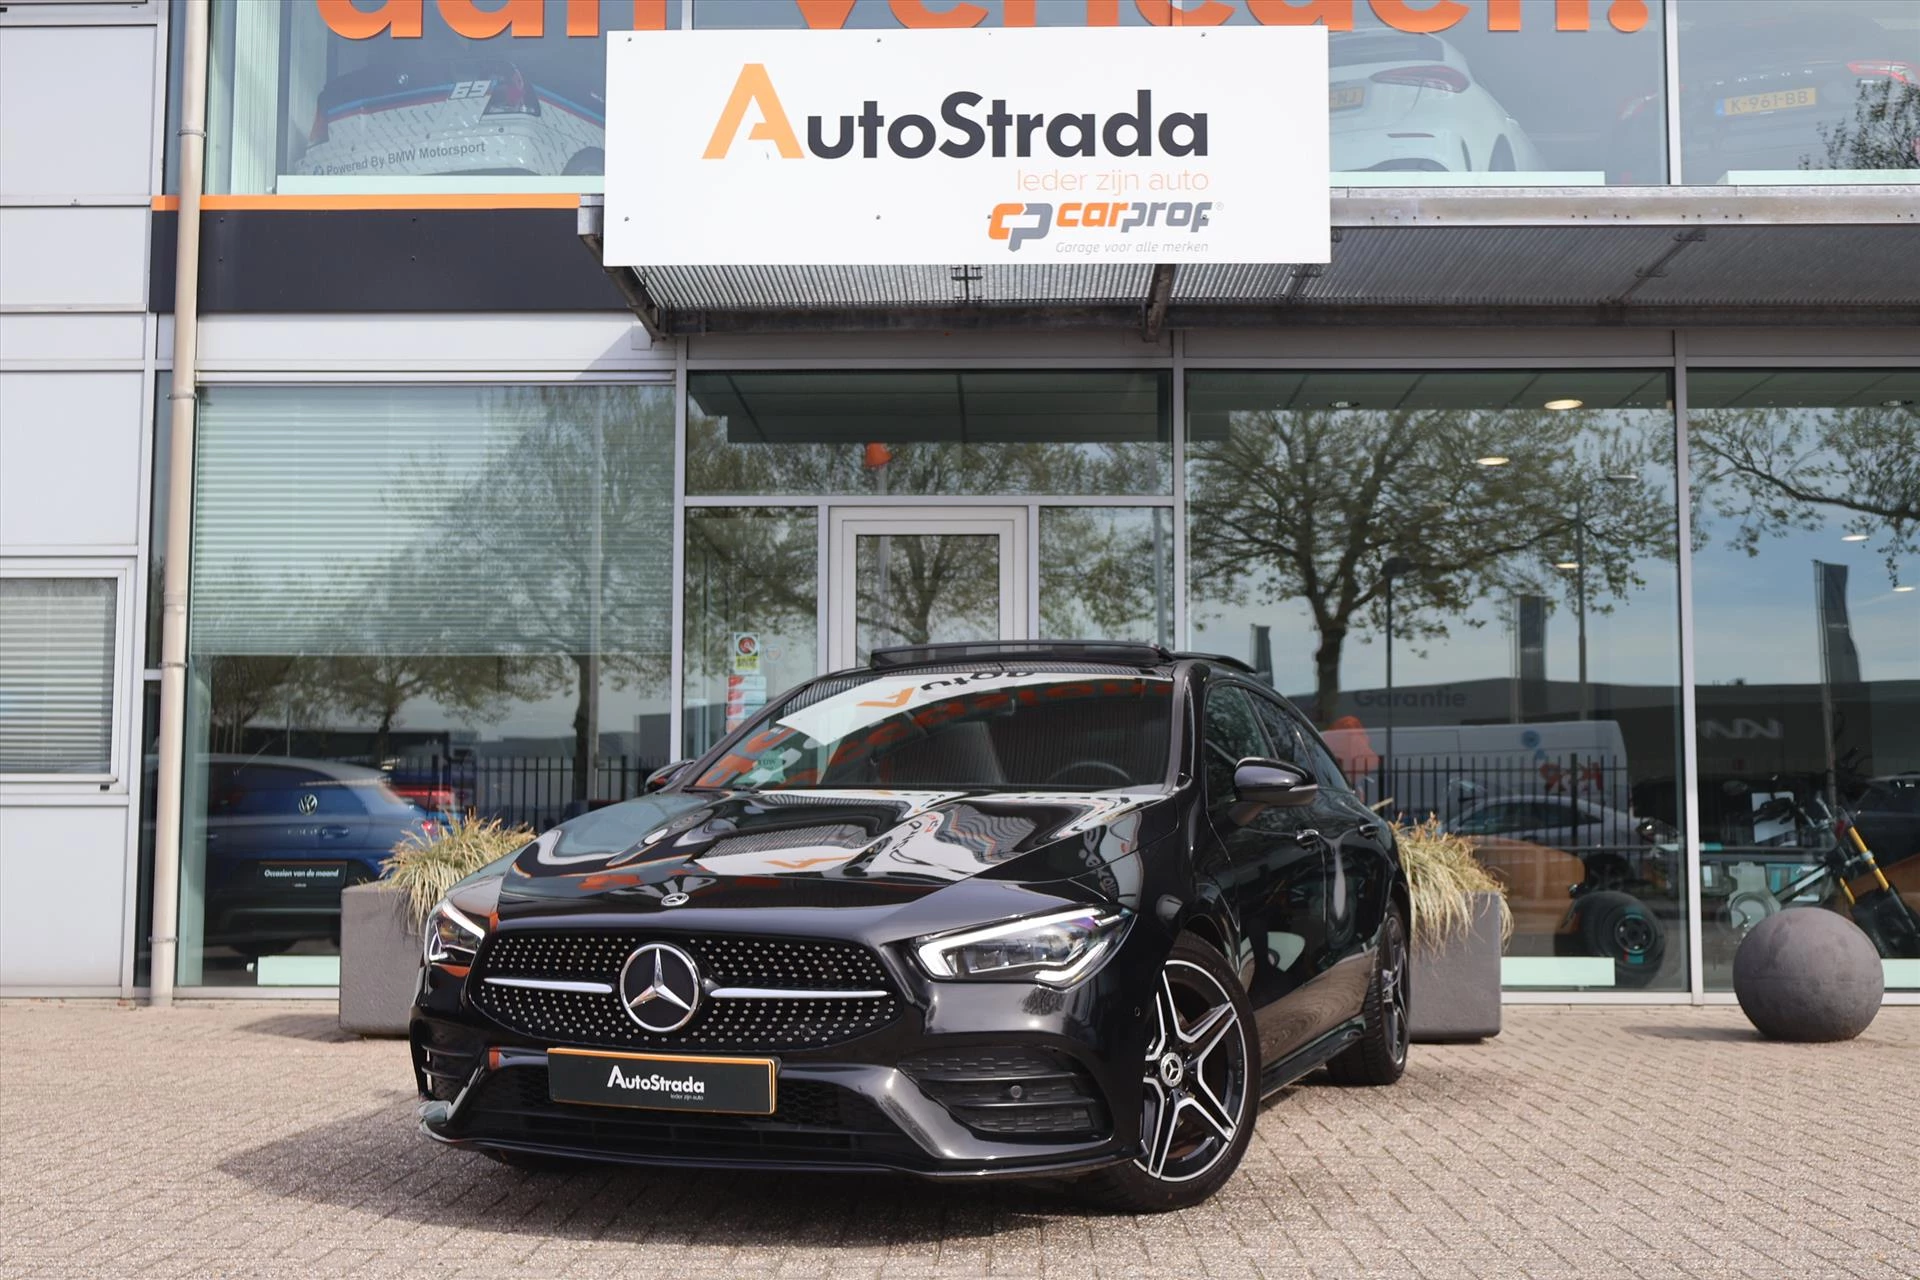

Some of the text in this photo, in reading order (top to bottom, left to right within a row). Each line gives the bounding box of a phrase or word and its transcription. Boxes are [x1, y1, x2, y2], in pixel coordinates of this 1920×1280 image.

[450, 80, 491, 98] 69
[701, 63, 1209, 159] AutoStrada
[326, 142, 486, 176] Powered By BMW Motorsport
[1017, 170, 1209, 196] Ieder zijn auto
[1056, 241, 1209, 256] Garage voor alle merken
[1355, 686, 1467, 708] Garantie
[264, 868, 292, 878] Occasion
[294, 870, 306, 878] van
[307, 868, 315, 878] de
[607, 1065, 705, 1093] AutoStrada
